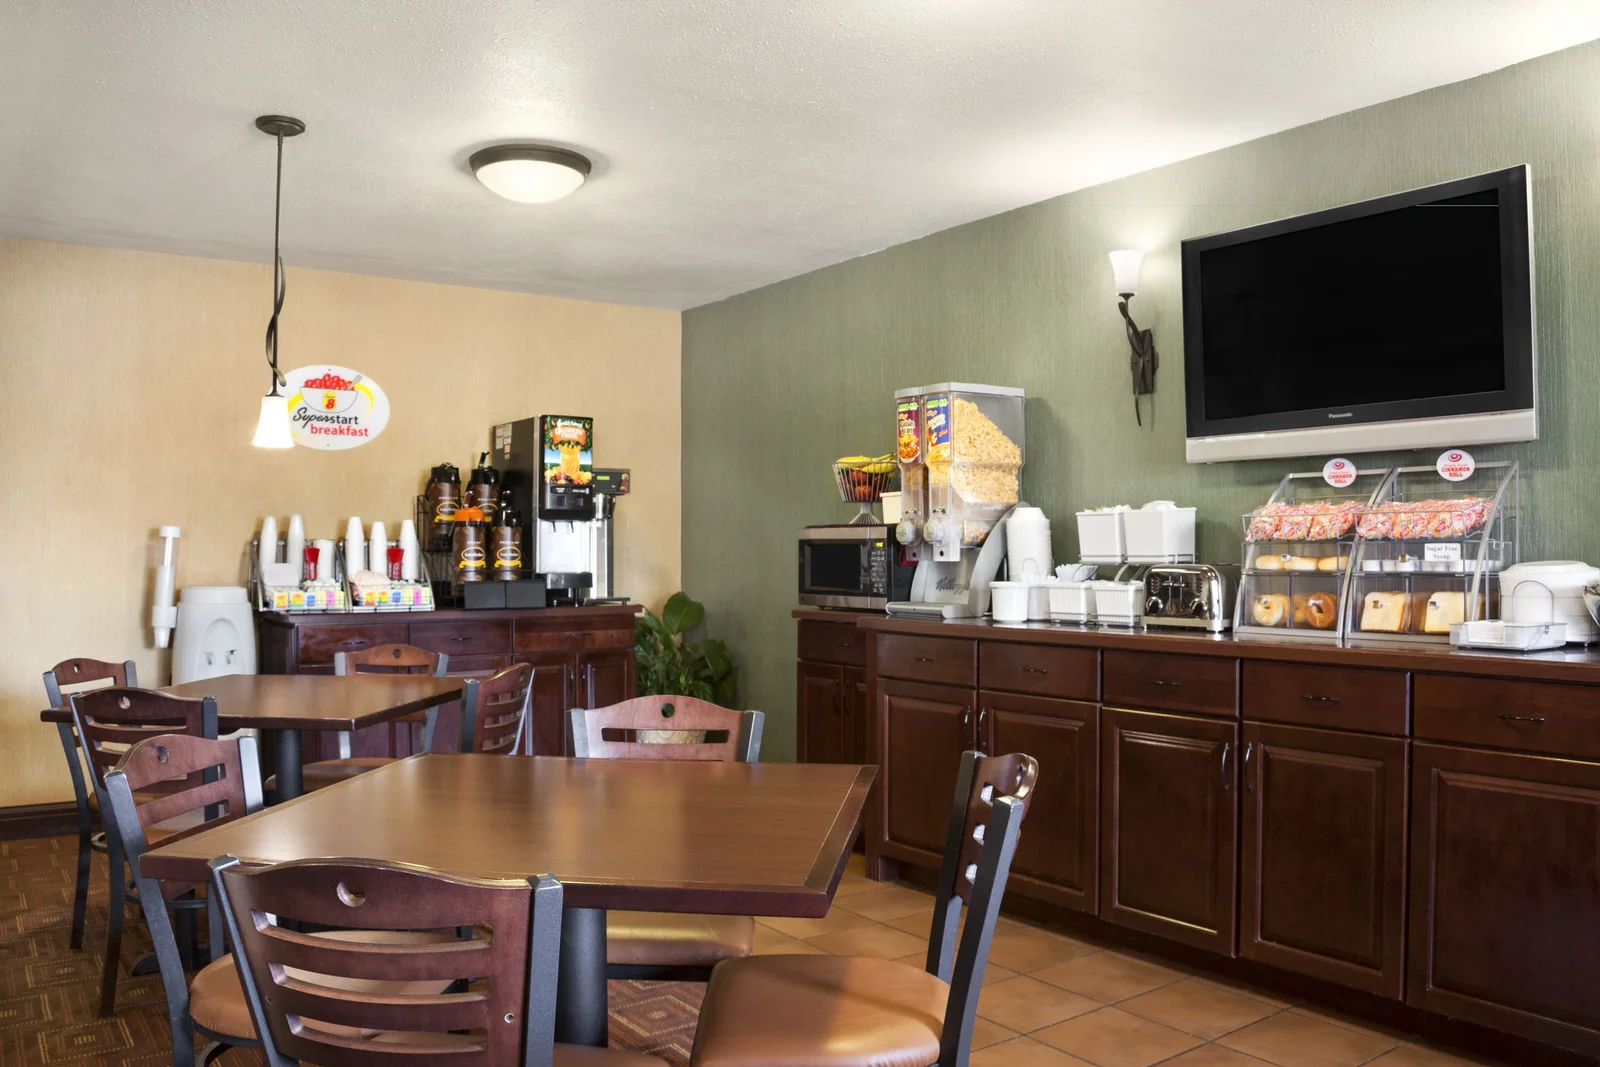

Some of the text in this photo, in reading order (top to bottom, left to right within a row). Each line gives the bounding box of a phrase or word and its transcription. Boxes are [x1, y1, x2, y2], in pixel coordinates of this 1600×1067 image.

[326, 398, 336, 410] 8
[292, 406, 359, 429] Superstart
[310, 423, 369, 437] breakfast
